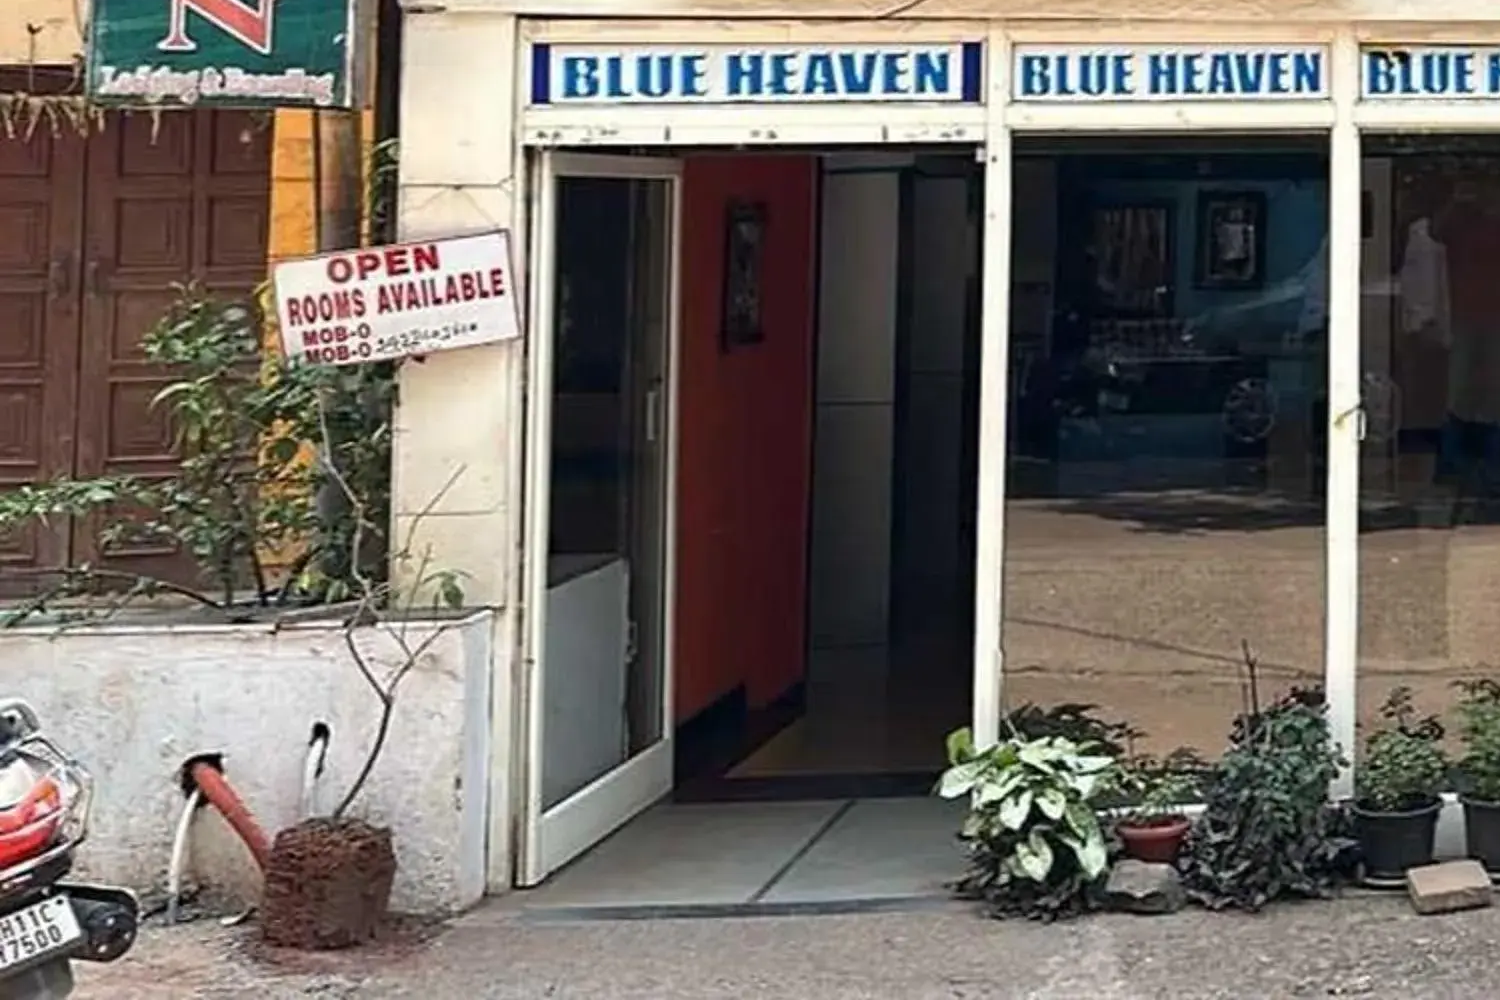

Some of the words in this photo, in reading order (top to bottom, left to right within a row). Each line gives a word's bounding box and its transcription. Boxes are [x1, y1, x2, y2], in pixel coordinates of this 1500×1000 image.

[562, 51, 707, 98] BLUE
[726, 51, 951, 96] HEAVEN
[1021, 53, 1136, 95] BLUE
[1148, 52, 1321, 95] HEAVEN
[1367, 51, 1477, 95] BLUE
[326, 244, 441, 283] OPEN
[286, 287, 367, 327] ROOMS
[376, 268, 505, 316] AVAILABLE
